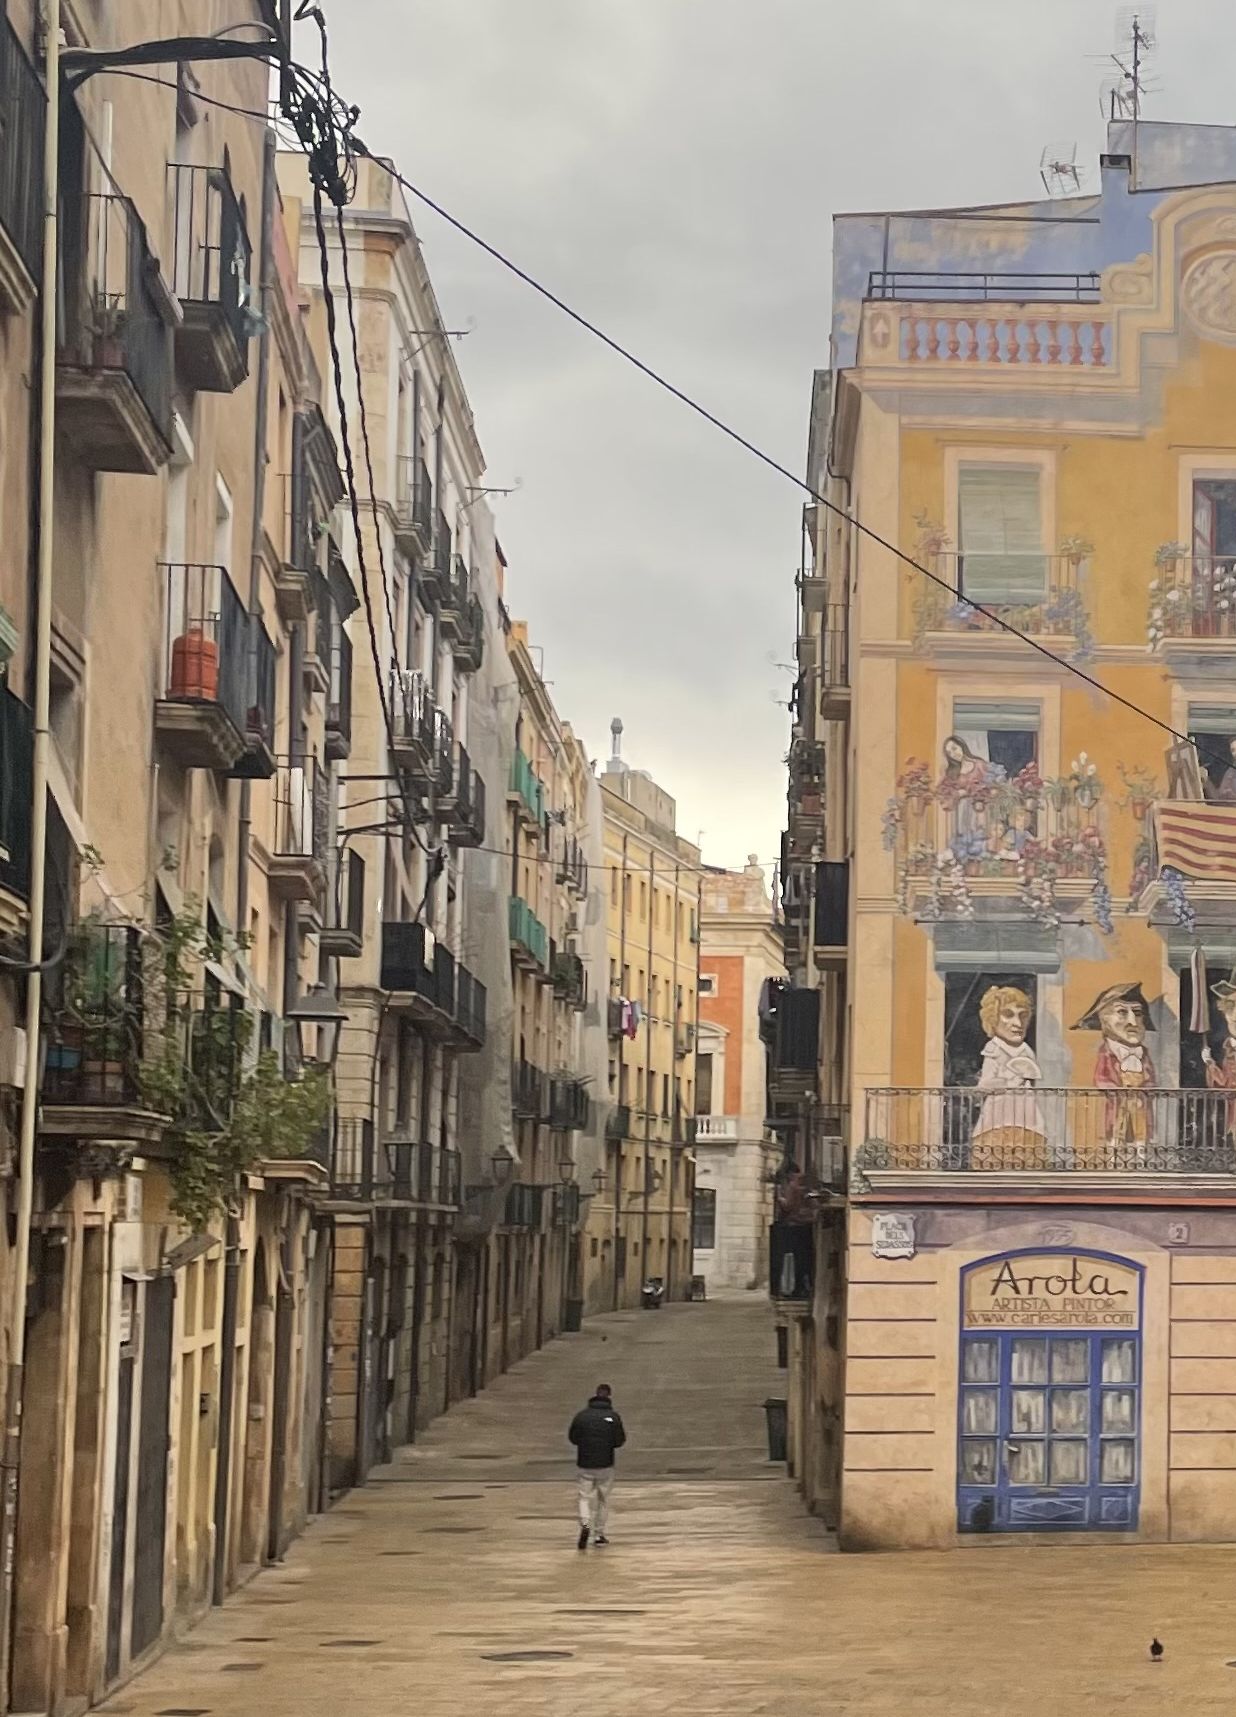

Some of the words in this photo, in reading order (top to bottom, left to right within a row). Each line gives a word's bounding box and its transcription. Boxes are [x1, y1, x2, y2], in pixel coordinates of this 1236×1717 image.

[1175, 1227, 1184, 1239] 2
[990, 1257, 1128, 1296] Arola
[992, 1298, 1050, 1310] ARTISTA
[1063, 1298, 1115, 1310] PINTOR
